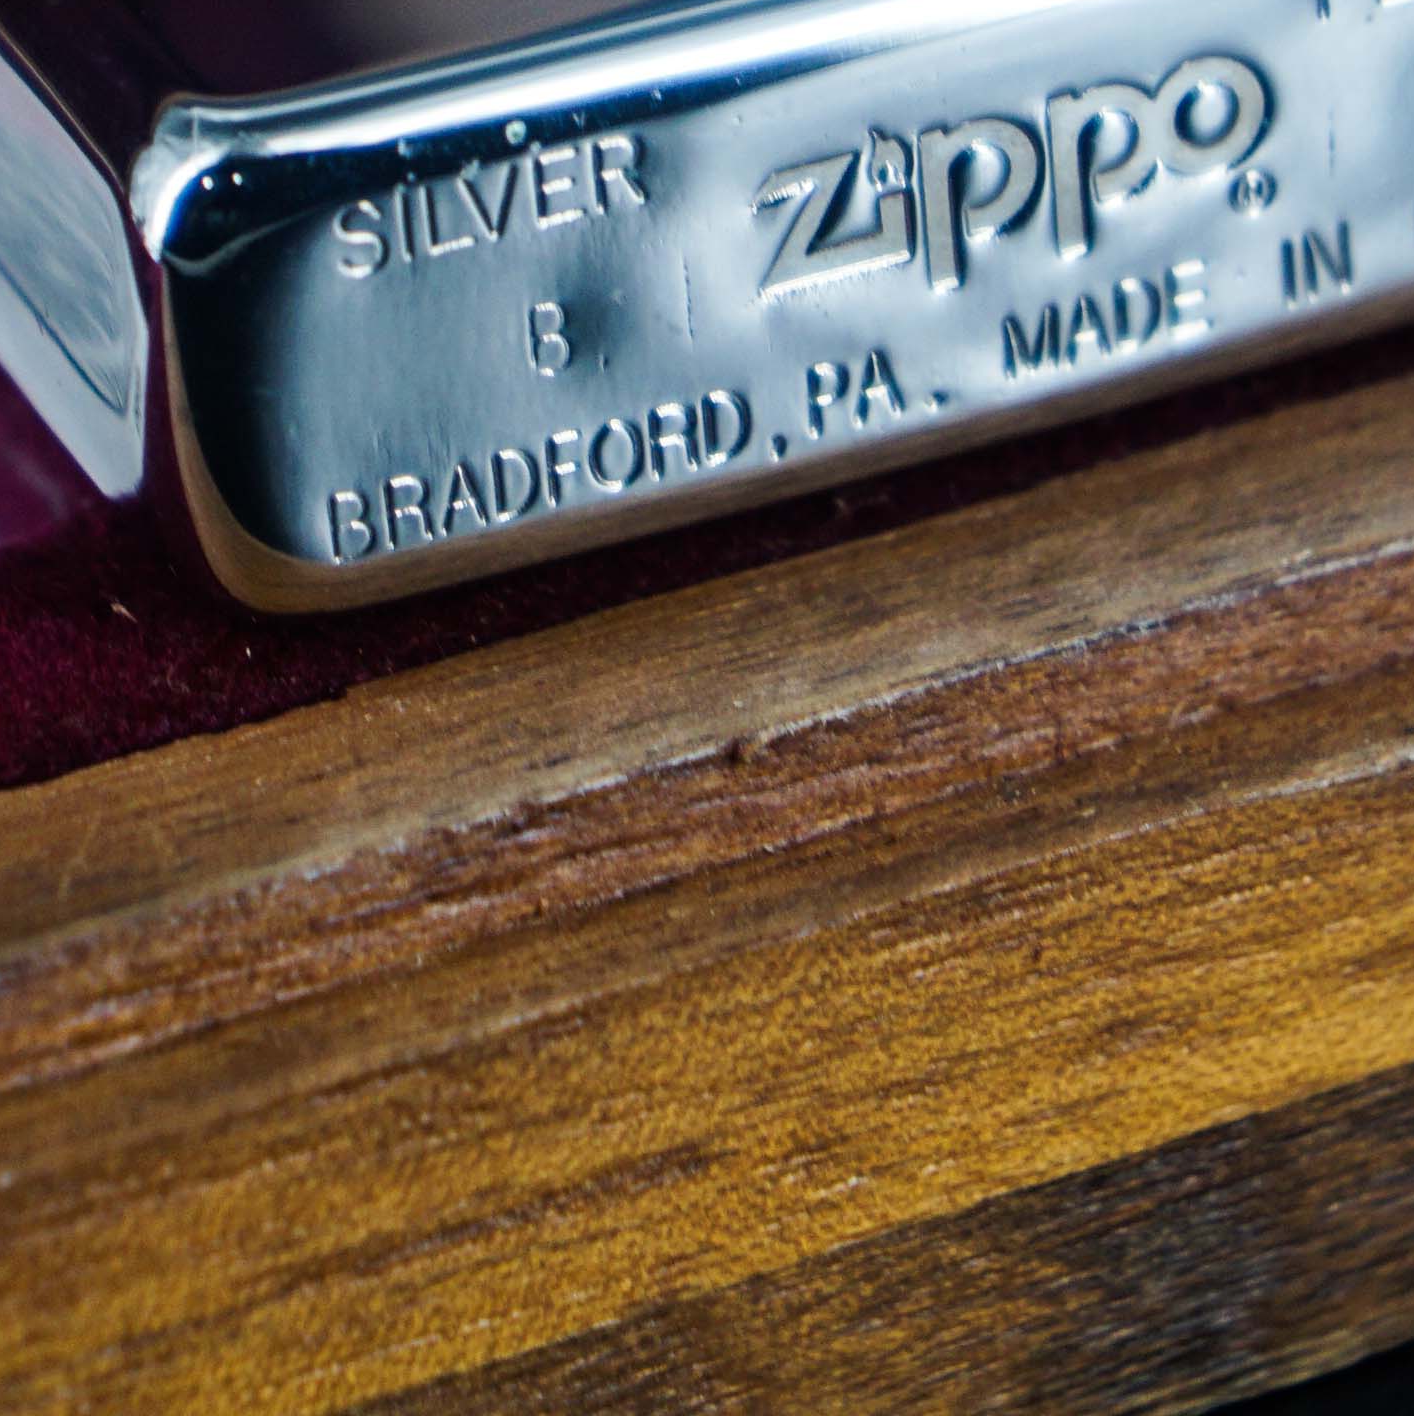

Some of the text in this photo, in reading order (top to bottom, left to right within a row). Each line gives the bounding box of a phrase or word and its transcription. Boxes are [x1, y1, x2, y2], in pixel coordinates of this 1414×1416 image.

[333, 132, 647, 280] SILVER
[749, 53, 1276, 304] zippo
[526, 300, 573, 377] B
[1001, 258, 1213, 379] MADE
[1279, 219, 1355, 309] IN
